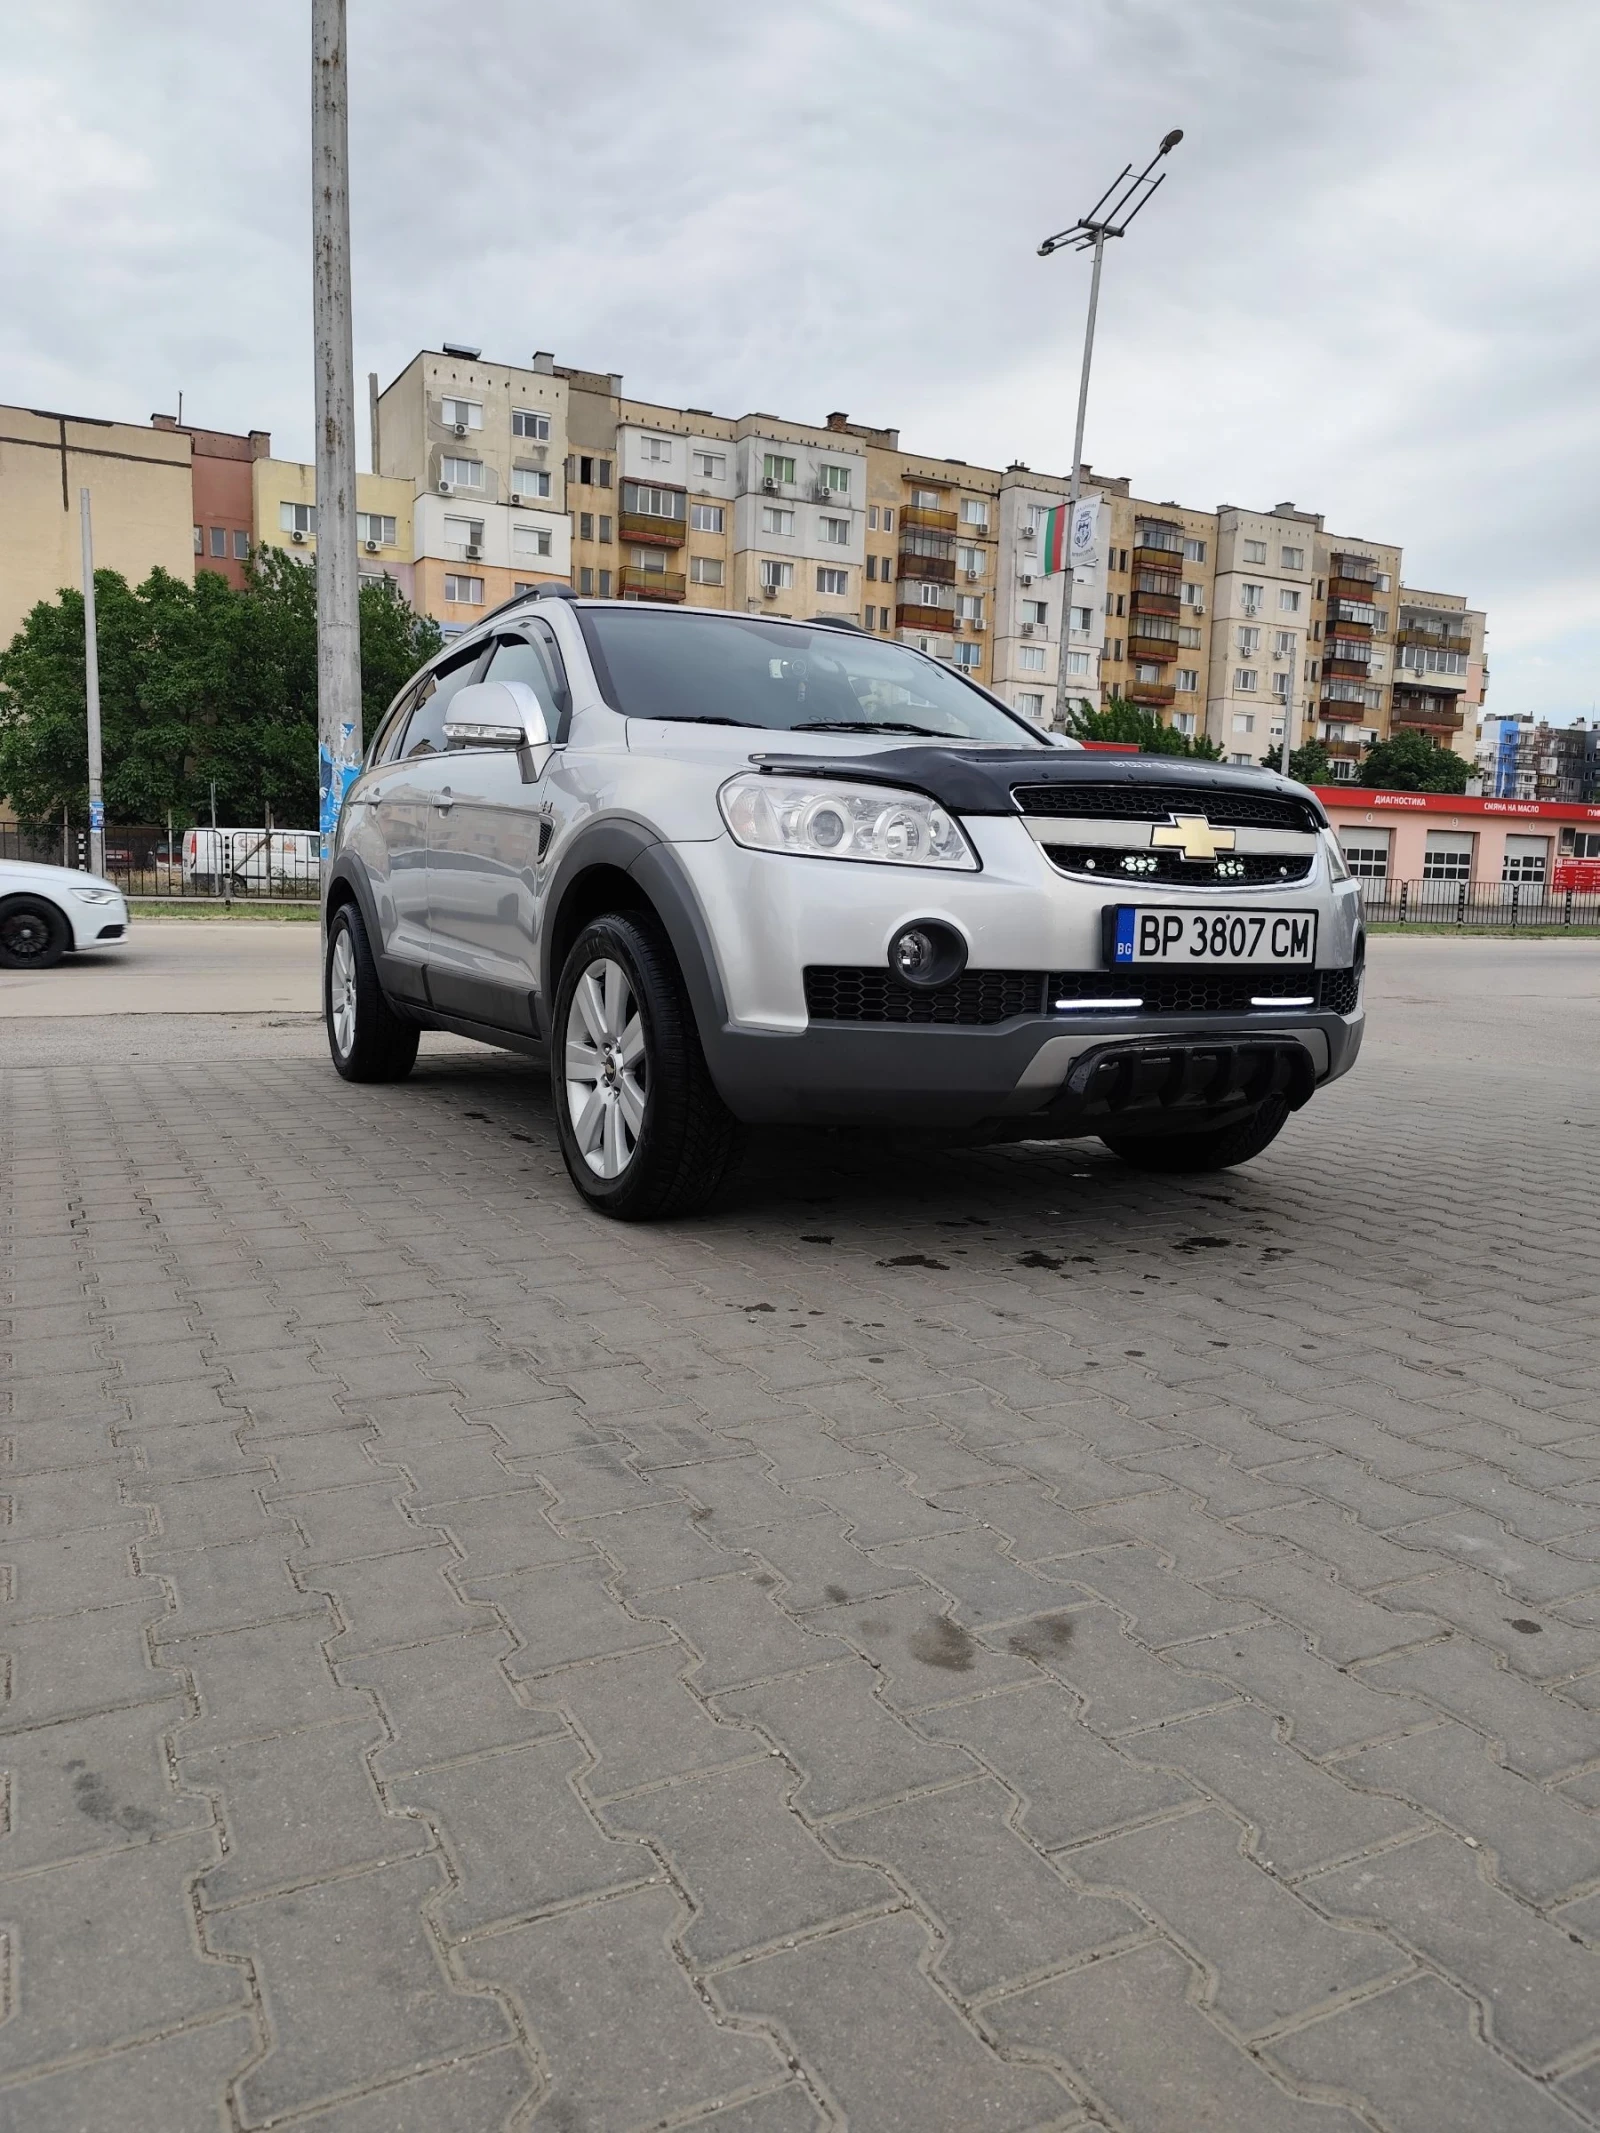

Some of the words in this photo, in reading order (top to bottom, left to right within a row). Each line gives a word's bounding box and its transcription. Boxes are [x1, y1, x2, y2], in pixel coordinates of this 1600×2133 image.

[1374, 795, 1426, 806] ДИАГНОСТИКА
[1484, 802, 1506, 812] СМЯНА
[1507, 804, 1517, 812] НА
[1518, 805, 1539, 813] МАСЛО
[1117, 942, 1132, 955] BG
